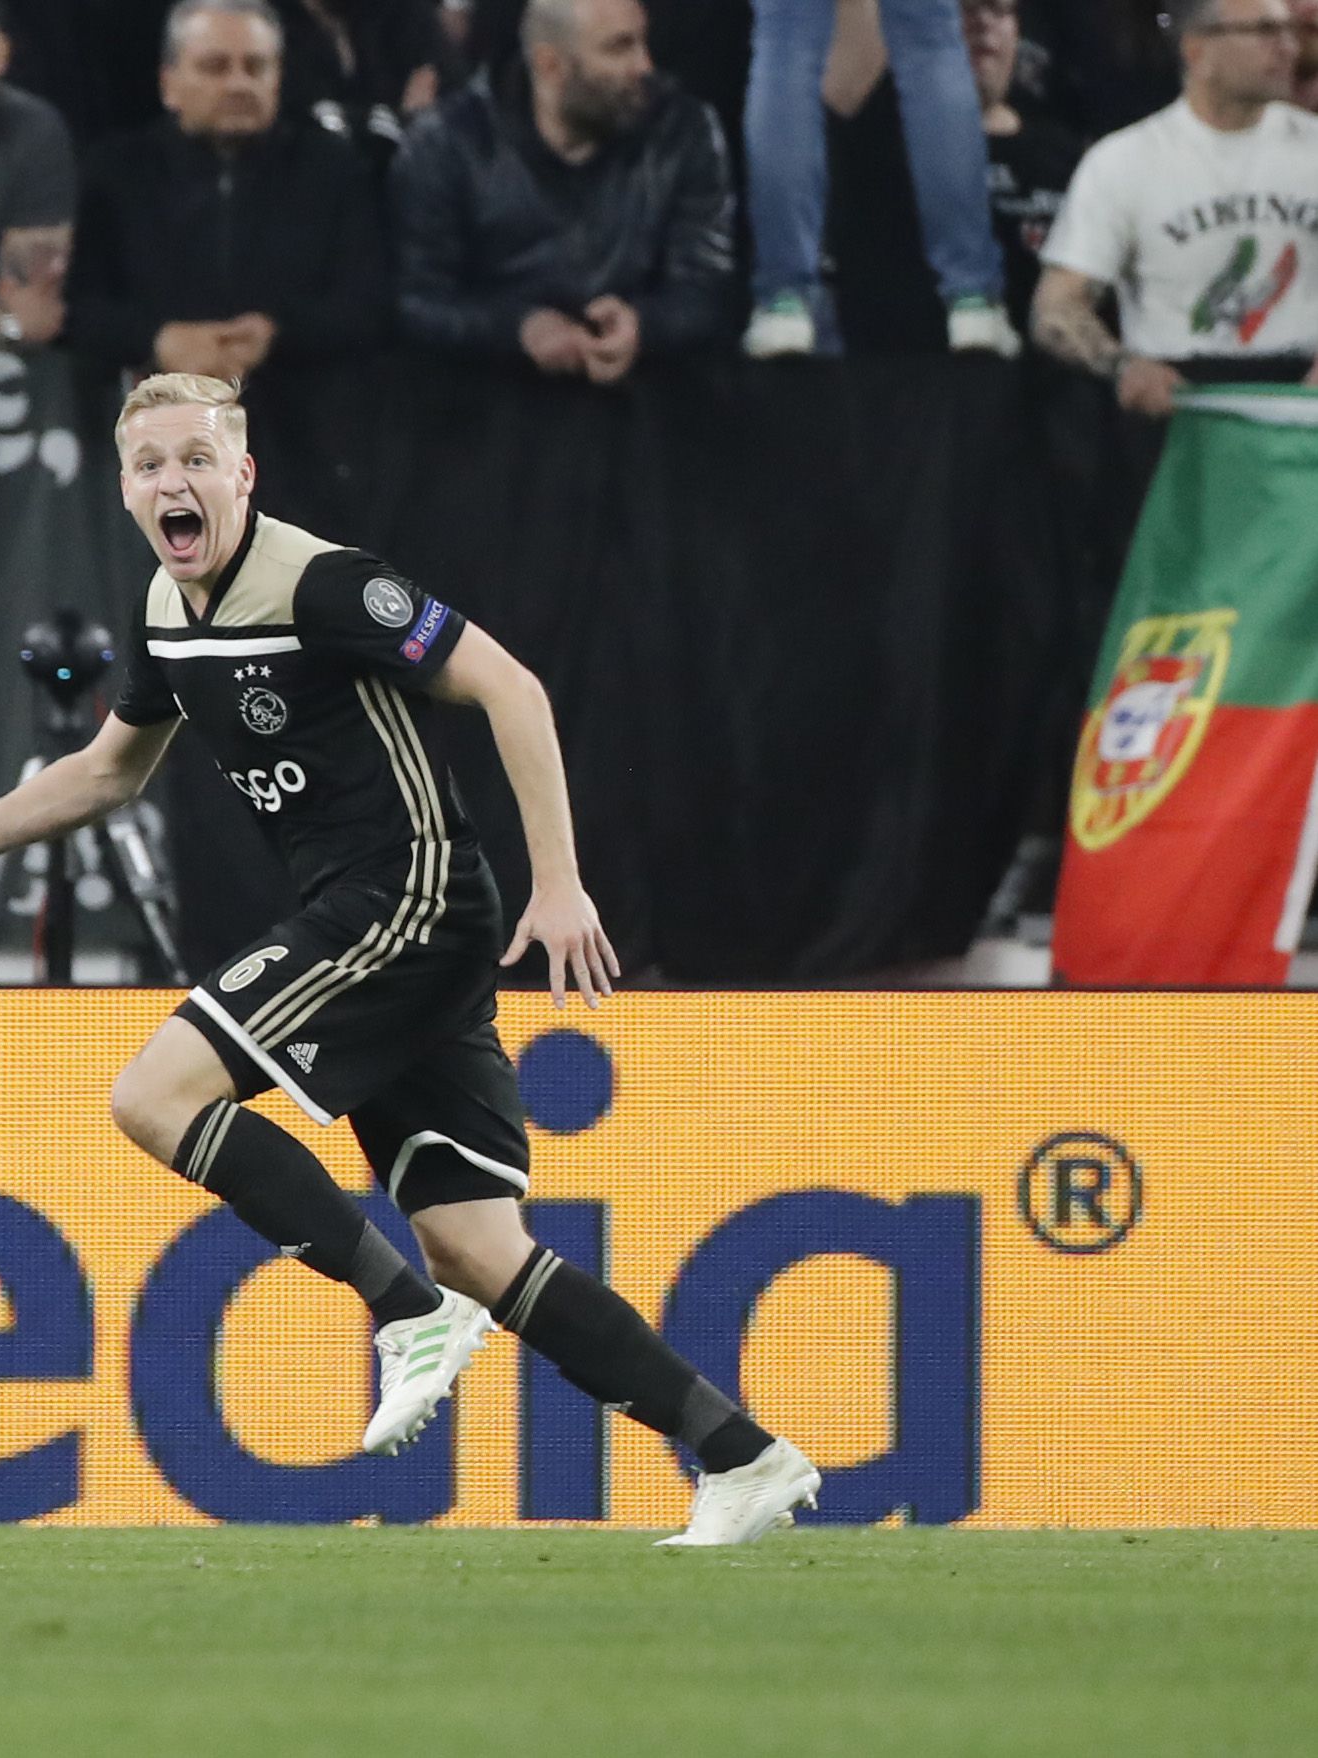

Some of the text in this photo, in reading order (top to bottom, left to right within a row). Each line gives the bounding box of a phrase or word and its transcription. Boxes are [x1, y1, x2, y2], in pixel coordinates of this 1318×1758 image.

[216, 760, 306, 813] ggo
[219, 945, 289, 992] 6
[286, 1044, 313, 1074] adidas
